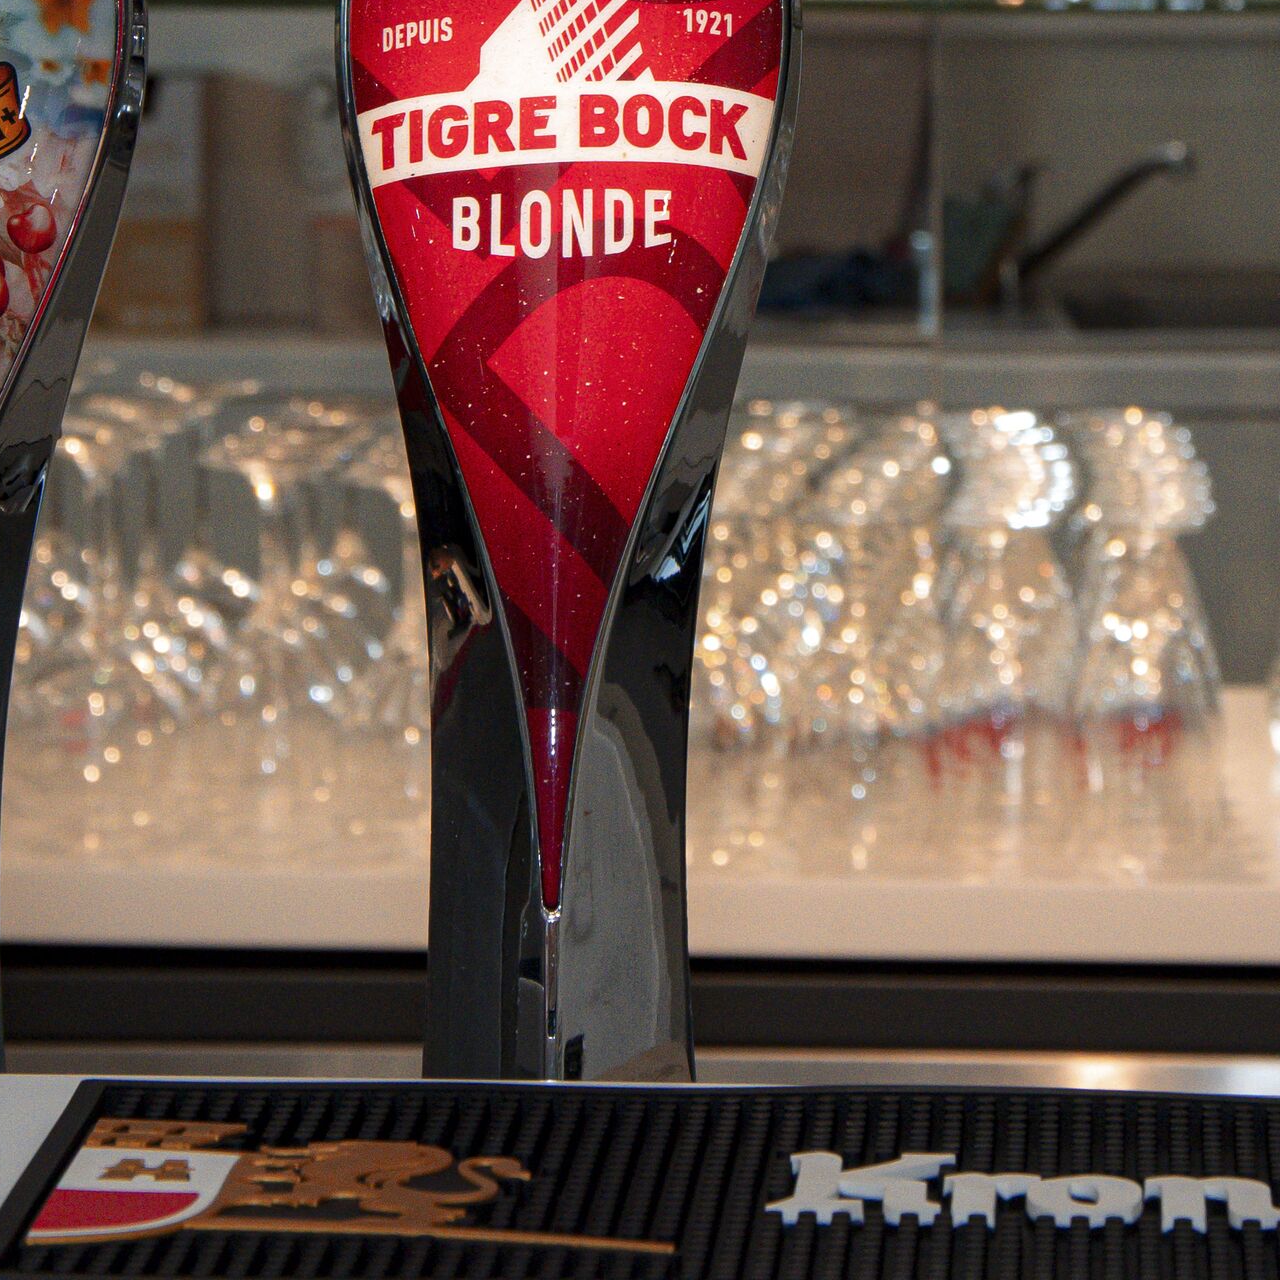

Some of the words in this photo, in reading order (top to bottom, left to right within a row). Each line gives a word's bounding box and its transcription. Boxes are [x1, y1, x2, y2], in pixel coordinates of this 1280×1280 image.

[382, 16, 454, 53] DEPUIS
[683, 8, 734, 38] 1921
[370, 95, 558, 172] TIGRE
[579, 93, 750, 161] BOCK
[452, 187, 674, 260] BLONDE
